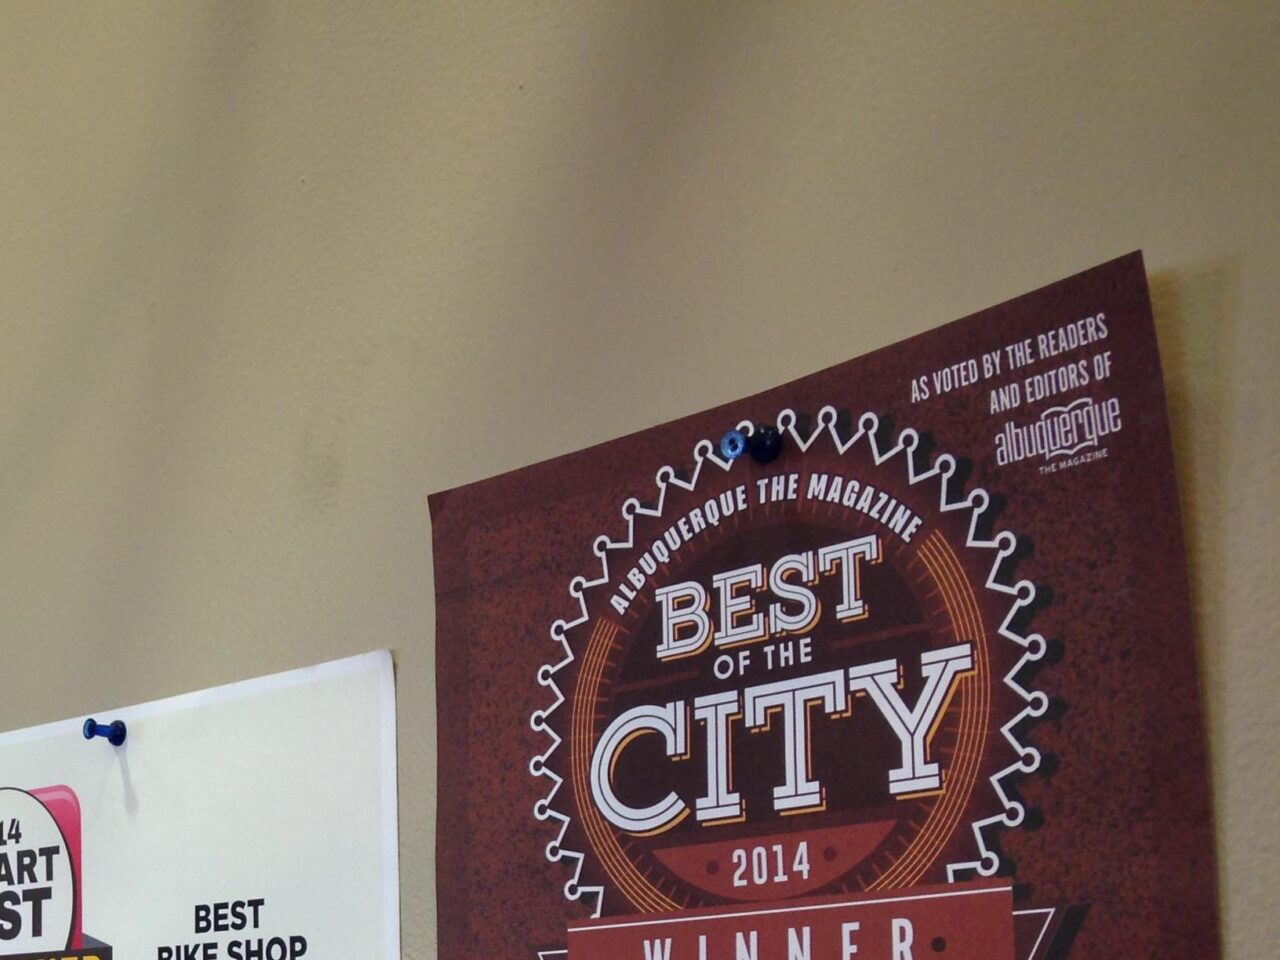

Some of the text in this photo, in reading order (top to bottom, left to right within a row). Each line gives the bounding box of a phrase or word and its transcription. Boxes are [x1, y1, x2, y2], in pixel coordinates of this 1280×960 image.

[911, 312, 1109, 403] AS VOTED BY THE READERS
[989, 351, 1112, 415] AND EDITORS OF
[994, 397, 1122, 466] albuquerque
[1038, 447, 1109, 476] THE MAGAZINE
[610, 473, 923, 616] ALBUQUERQUE THE MAGAZINE
[655, 534, 881, 661] BEST
[713, 637, 813, 680] OF THE
[590, 643, 974, 833] CITY
[732, 841, 811, 888] 2014
[195, 898, 265, 934] BEST
